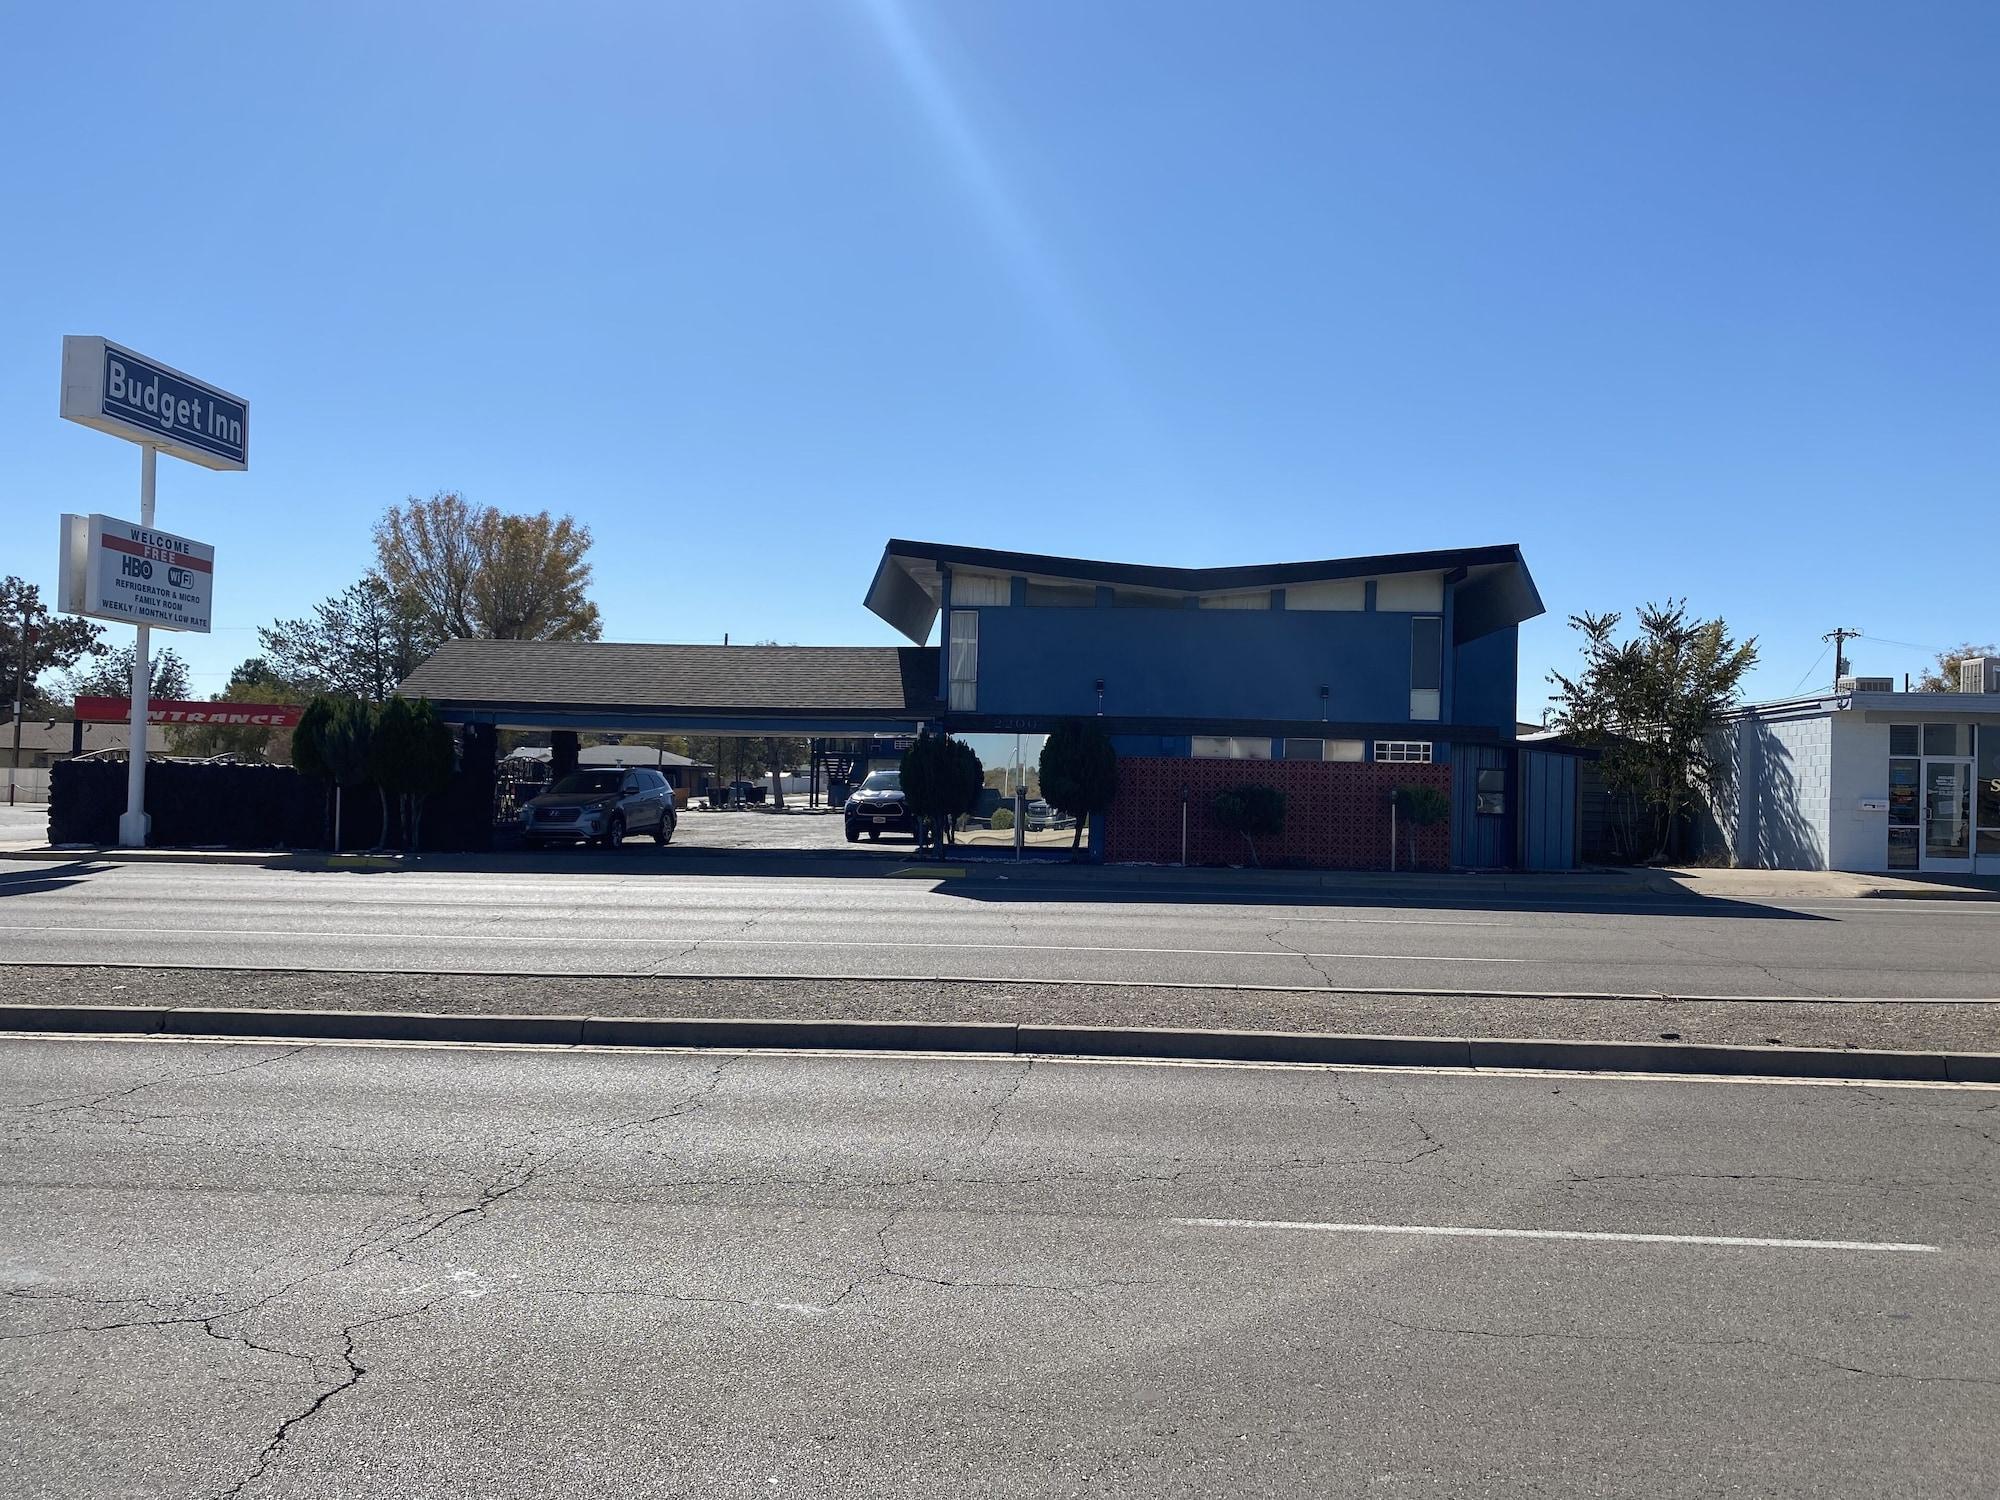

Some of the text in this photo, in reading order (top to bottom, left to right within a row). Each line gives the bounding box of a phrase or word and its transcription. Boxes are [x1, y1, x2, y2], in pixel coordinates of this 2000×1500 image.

[109, 360, 242, 444] Budget Inn
[131, 530, 190, 554] WELCOME
[144, 546, 176, 563] FREE
[122, 555, 153, 580] HBO
[115, 578, 170, 598] REFRIGERATOR
[179, 592, 201, 604] MICRO
[135, 594, 183, 611] FAMILY ROOM
[102, 599, 133, 613] WEEKLY
[139, 607, 173, 621] MONTHLY
[174, 613, 189, 624] LOW
[191, 617, 208, 627] RATE
[125, 709, 285, 725] NTRANCE
